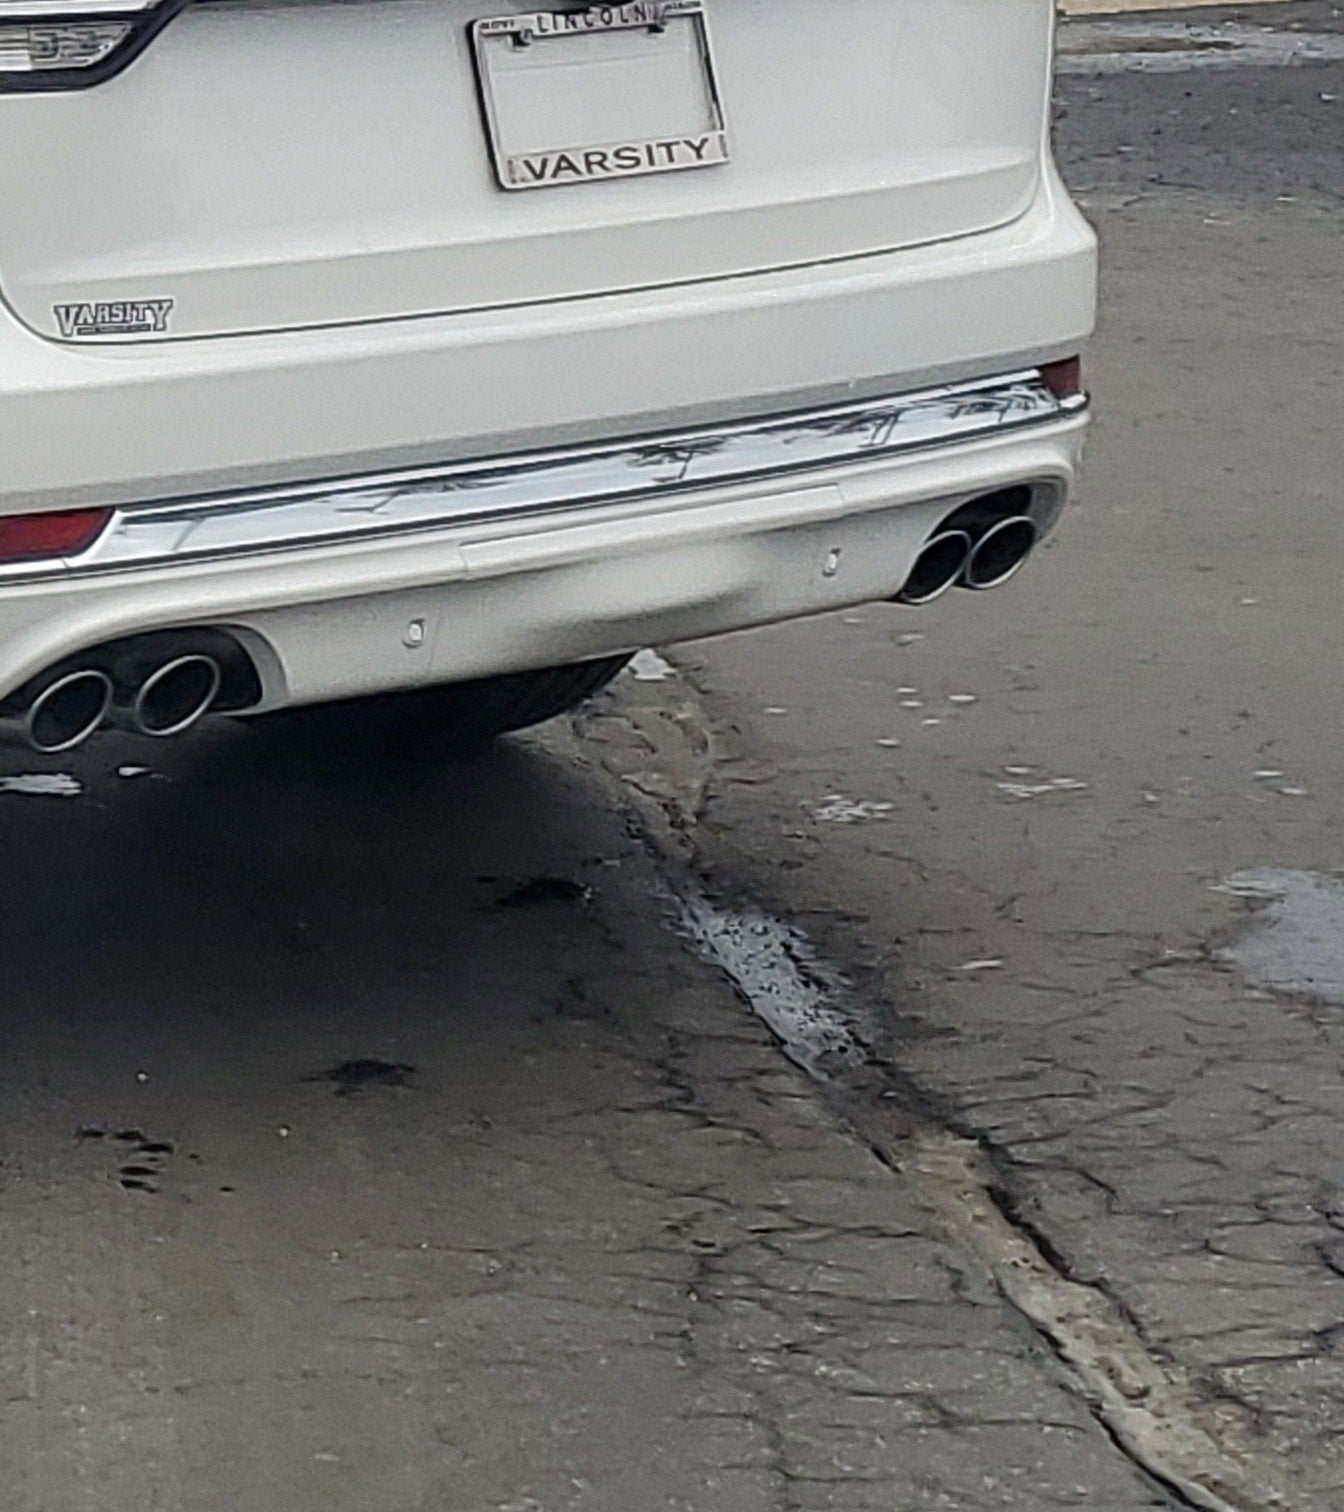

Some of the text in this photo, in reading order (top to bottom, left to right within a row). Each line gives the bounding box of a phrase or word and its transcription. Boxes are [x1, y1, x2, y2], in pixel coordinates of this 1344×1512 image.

[536, 3, 648, 34] LINCOLN
[522, 136, 711, 181] VARSITY
[52, 298, 174, 337] VARSITY
